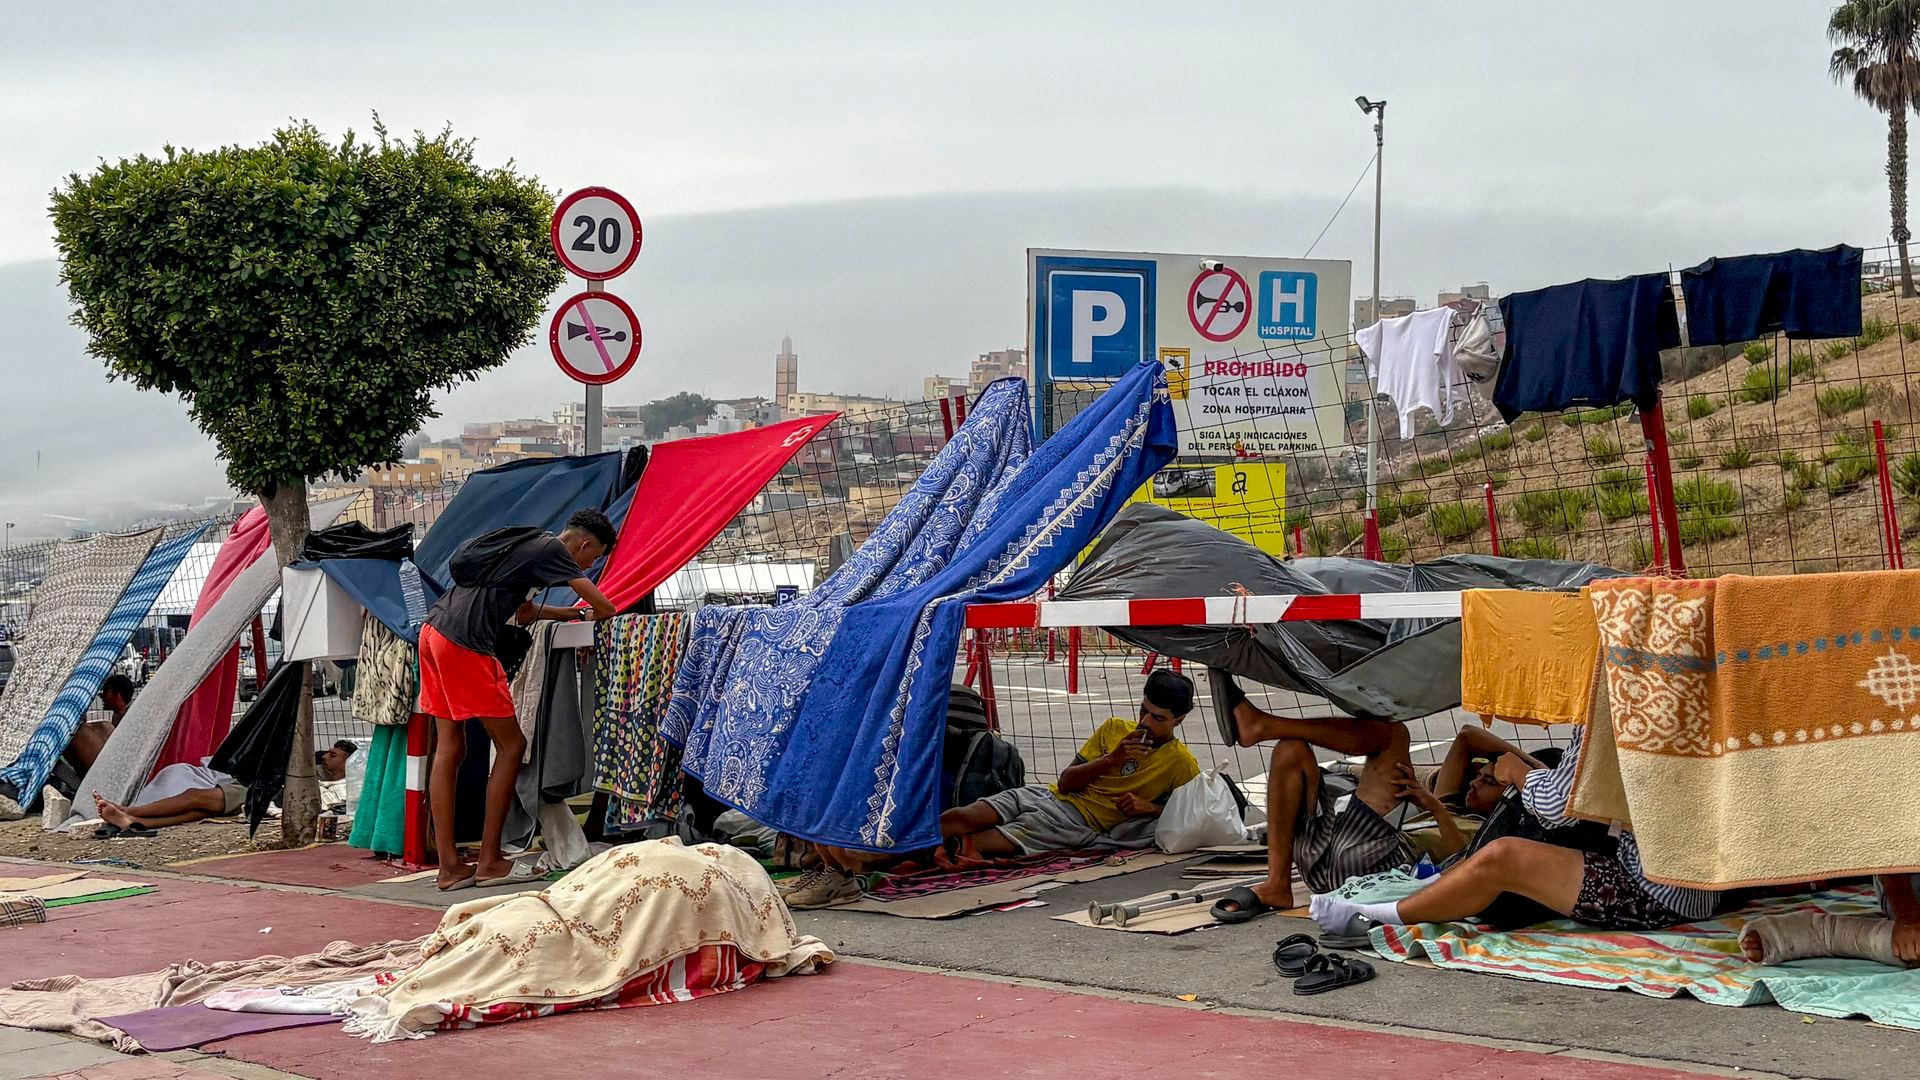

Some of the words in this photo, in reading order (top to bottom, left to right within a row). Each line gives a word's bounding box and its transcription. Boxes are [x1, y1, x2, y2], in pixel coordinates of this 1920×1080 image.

[571, 215, 621, 254] 20
[1271, 278, 1305, 323] H
[1072, 289, 1126, 363] P
[1261, 326, 1313, 336] HOSPITAL
[1204, 360, 1308, 378] PROHIBIDO
[1202, 387, 1240, 397] TOCAR
[1246, 387, 1259, 397] EL
[1203, 405, 1231, 414] ZONA
[1235, 405, 1306, 415] HOSPITALARIA
[1199, 431, 1221, 439] SIGA
[1224, 431, 1240, 439] LAS
[1244, 431, 1307, 440] INDICACIONES
[1188, 442, 1205, 450] DEL
[1260, 443, 1277, 451] DEL
[1279, 443, 1318, 451] PARKING
